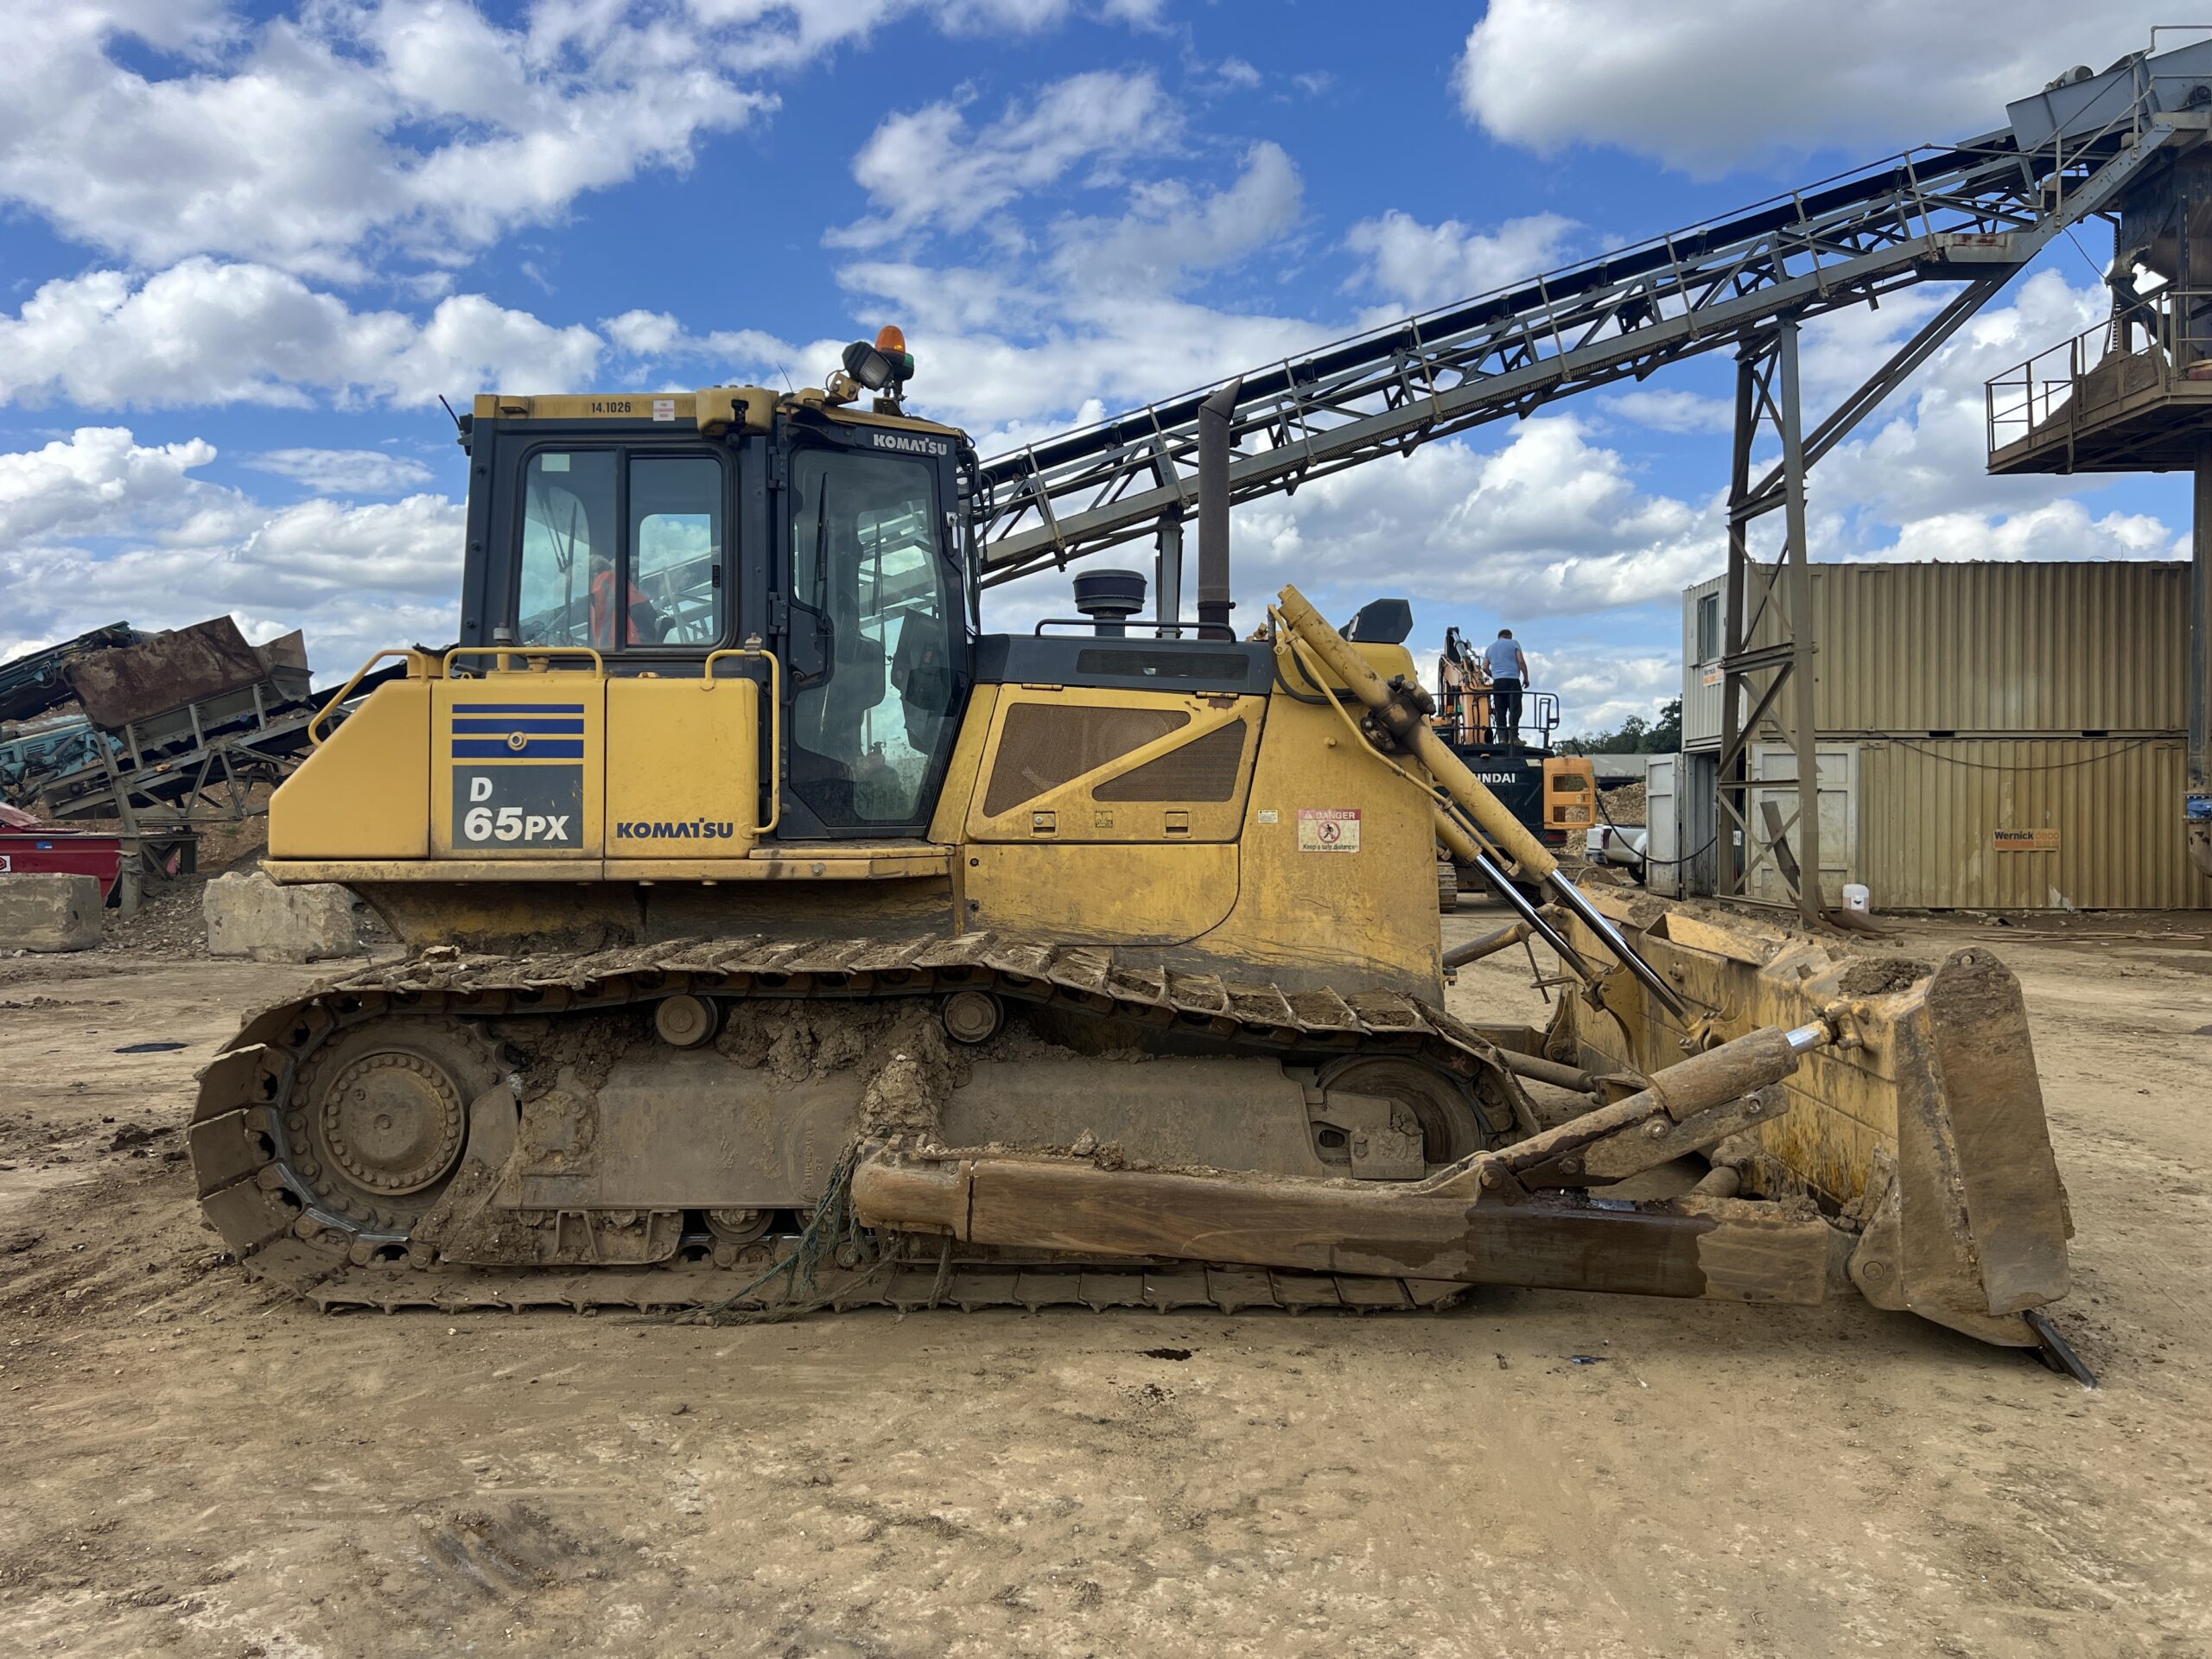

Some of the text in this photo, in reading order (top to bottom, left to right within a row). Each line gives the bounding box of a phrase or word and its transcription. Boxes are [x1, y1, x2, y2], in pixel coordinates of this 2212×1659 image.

[592, 402, 631, 413] 14.1026
[873, 434, 947, 455] KOMATSU
[469, 777, 493, 802] D
[464, 806, 570, 842] 65PX
[1315, 811, 1355, 820] DANGER
[616, 817, 734, 839] KOMATSU
[1994, 830, 2034, 840] Wernick
